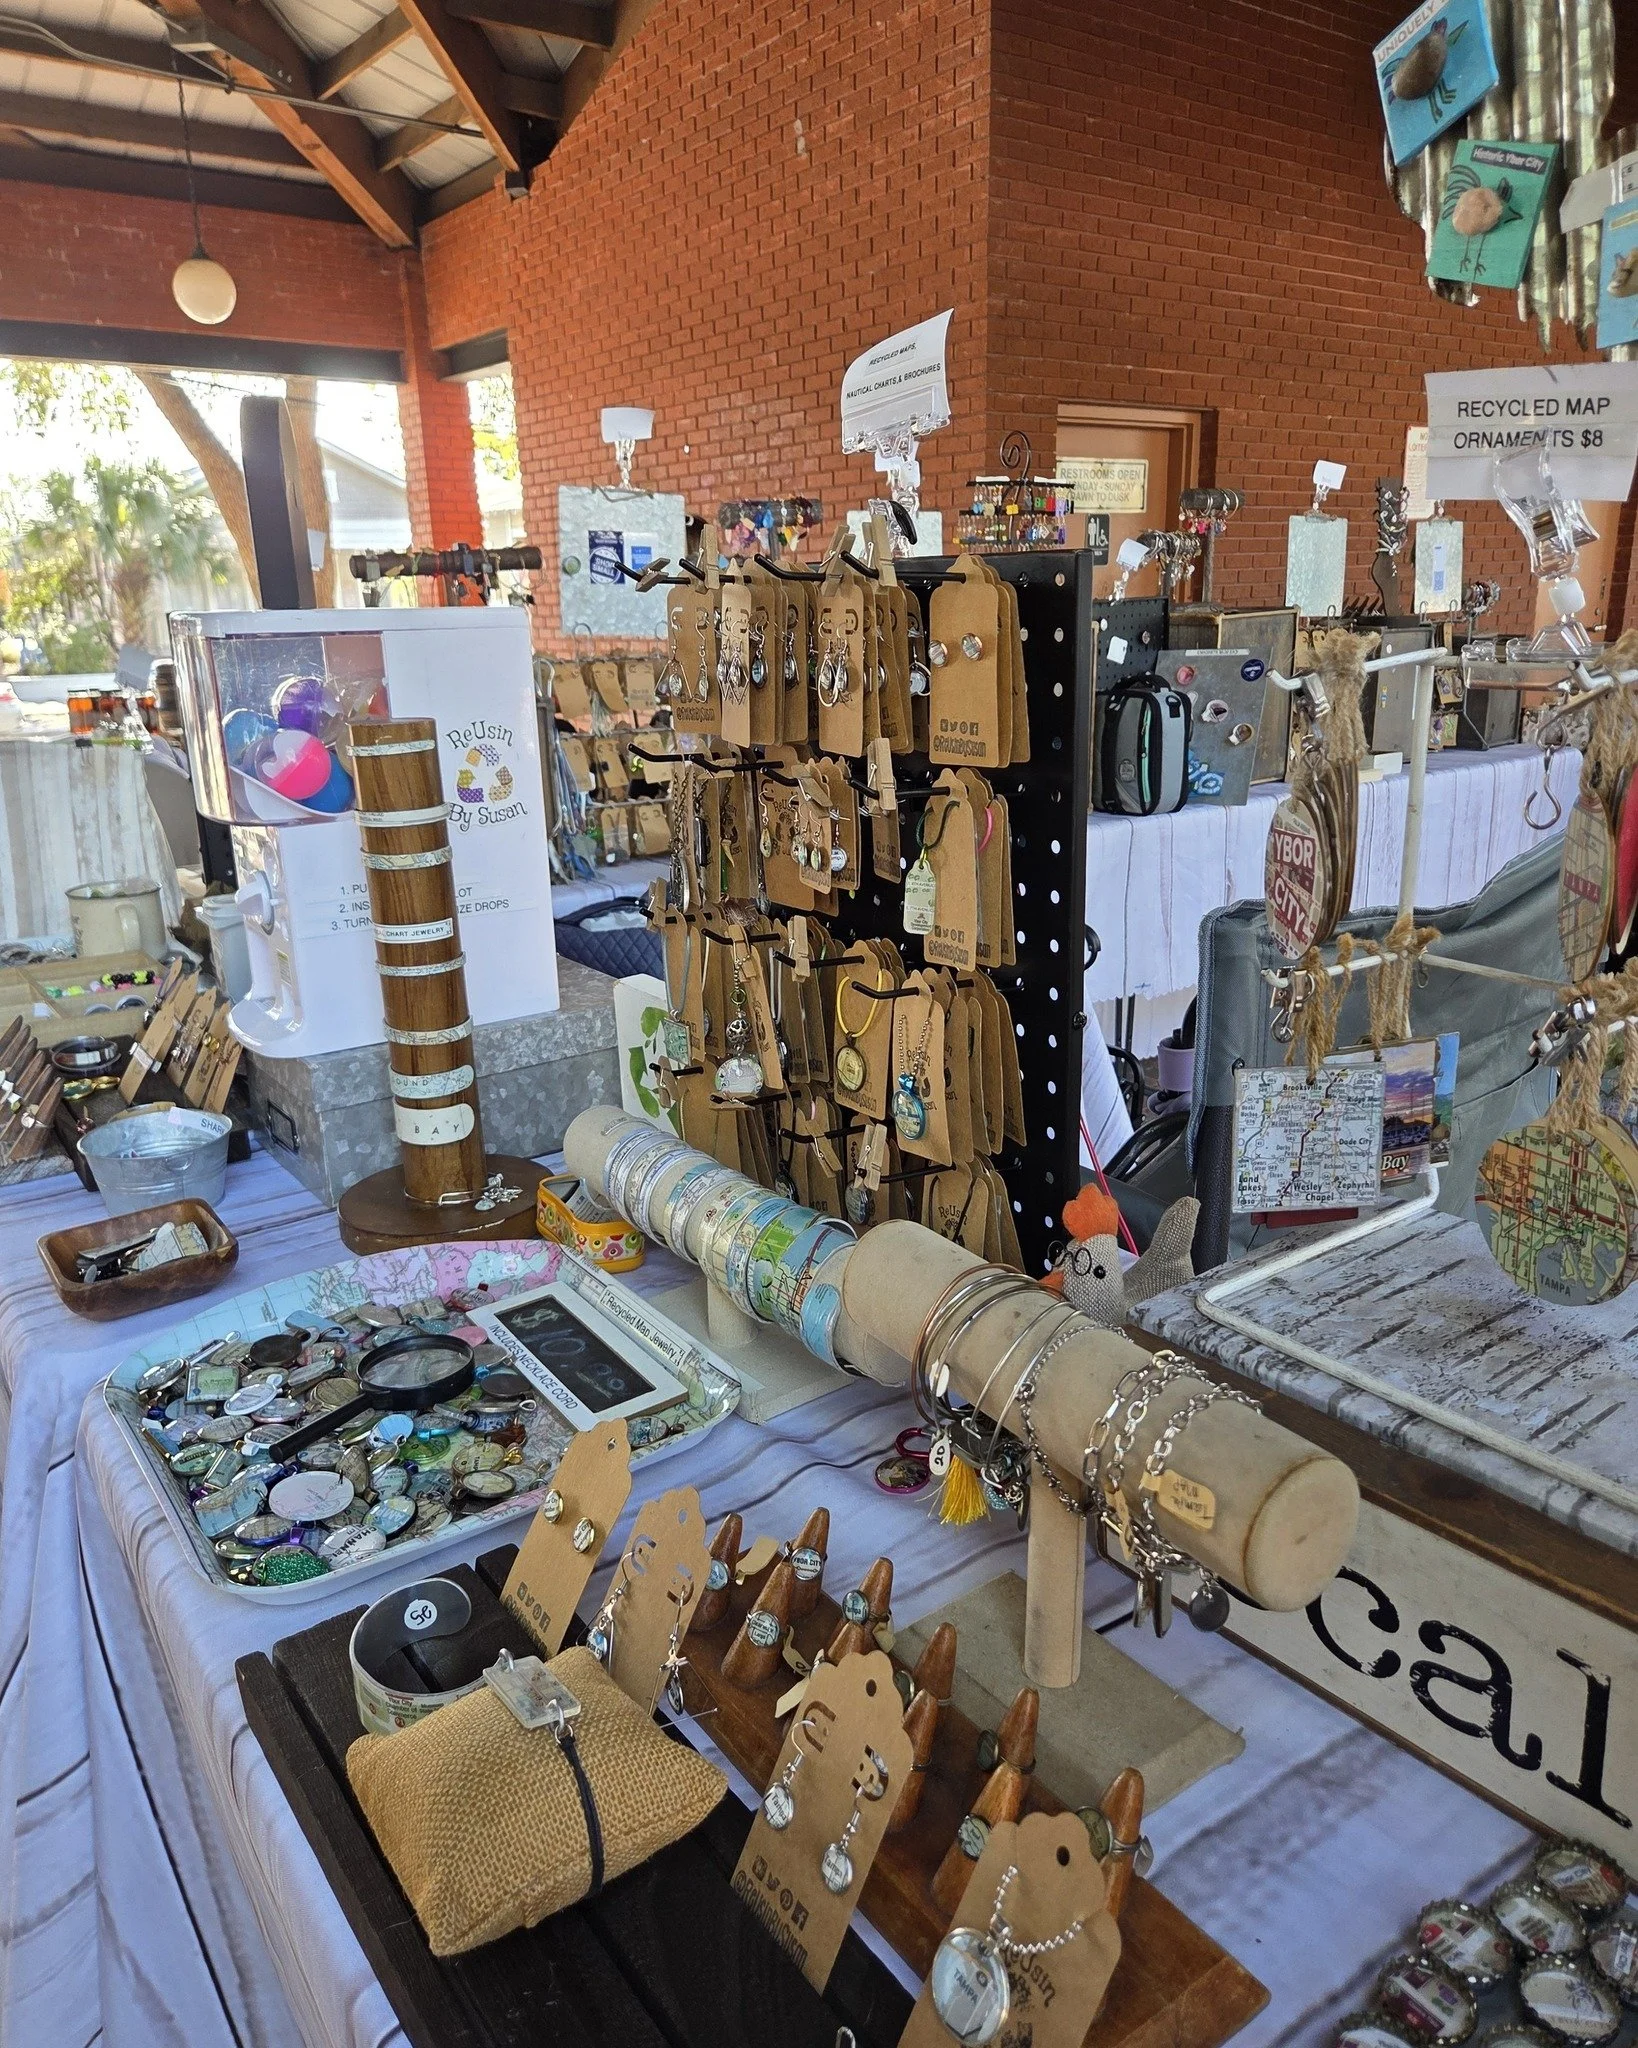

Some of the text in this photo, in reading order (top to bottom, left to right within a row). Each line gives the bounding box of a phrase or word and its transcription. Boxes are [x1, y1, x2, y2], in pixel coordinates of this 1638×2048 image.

[1377, 4, 1435, 63] UNIQUELY
[1473, 147, 1504, 163] Historic
[1526, 158, 1545, 173] City
[869, 350, 899, 366] RECYCLED
[846, 384, 873, 400] NAUTICAL
[904, 363, 941, 381] BROCHURES
[1457, 397, 1611, 418] RECYCLED MAP
[1453, 429, 1603, 449] ORNAMENTS $8
[1060, 468, 1140, 480] RESTROOMS OPEN
[1097, 491, 1106, 501] TO
[1108, 492, 1130, 502] DUSK
[1105, 482, 1136, 492] SUNDAY
[446, 720, 513, 749] ReUsin
[448, 801, 528, 832] By Susan
[1274, 832, 1313, 869] YBOR
[341, 886, 349, 895] 1.
[352, 884, 368, 893] PU
[339, 900, 510, 914] 2. INS IZE DROPS
[1274, 879, 1306, 934] CITY
[331, 917, 373, 931] 3. TURN
[386, 927, 444, 938] CHART JEWELRY
[396, 1078, 429, 1086] OUND
[415, 1123, 460, 1135] BAY
[1359, 1137, 1372, 1145] City
[1381, 1155, 1410, 1171] Bay
[1294, 1182, 1323, 1191] Wesley
[1305, 1192, 1334, 1203] Chapel
[938, 1205, 968, 1225] ReUsn
[1540, 1274, 1571, 1297] TAMPA
[606, 1295, 677, 1360] Recycled Map Jewelry
[488, 1323, 579, 1410] INCLUDES NECKLACE CORD
[1218, 1565, 1634, 1830] cal
[771, 1792, 787, 1823] Tampa
[823, 1852, 843, 1877] Tampa
[953, 1968, 979, 2004] TAMPA
